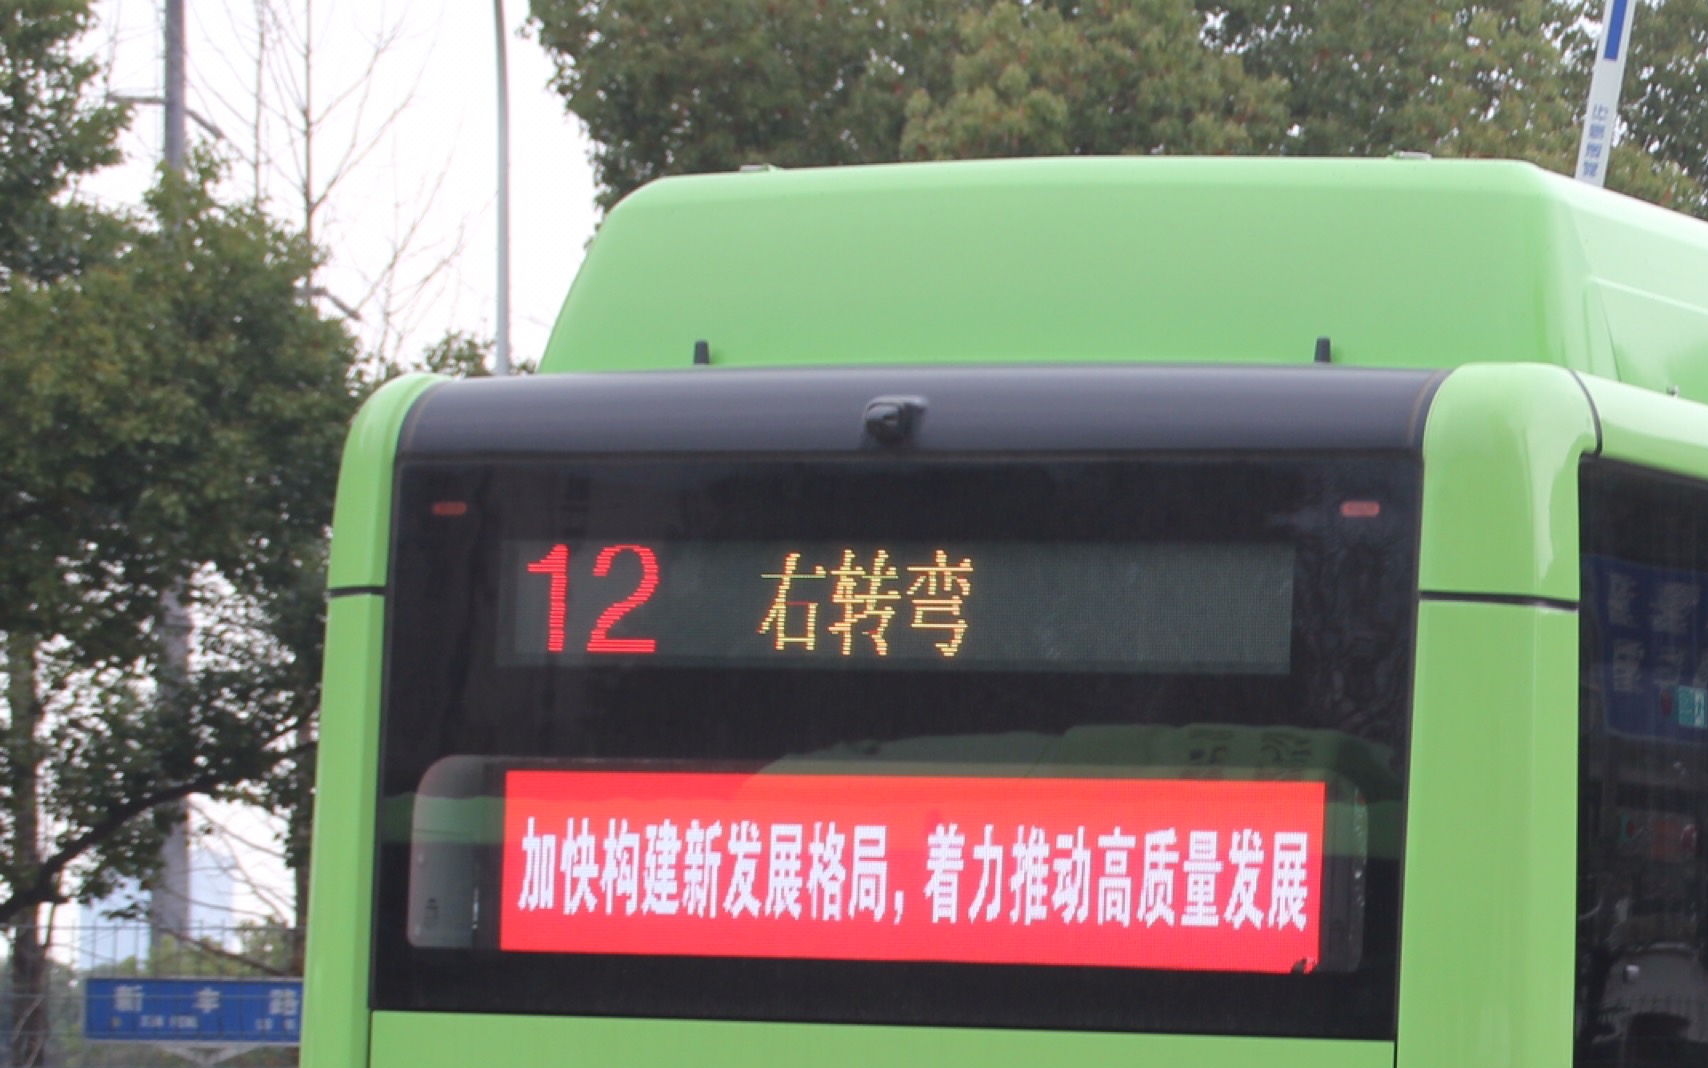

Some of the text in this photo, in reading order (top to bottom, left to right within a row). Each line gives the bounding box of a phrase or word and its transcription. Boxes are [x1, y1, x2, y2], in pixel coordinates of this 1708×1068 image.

[527, 544, 974, 657] 12 右转弯
[517, 816, 1309, 932] 加快构建新发展格局，着力推动高质量发展
